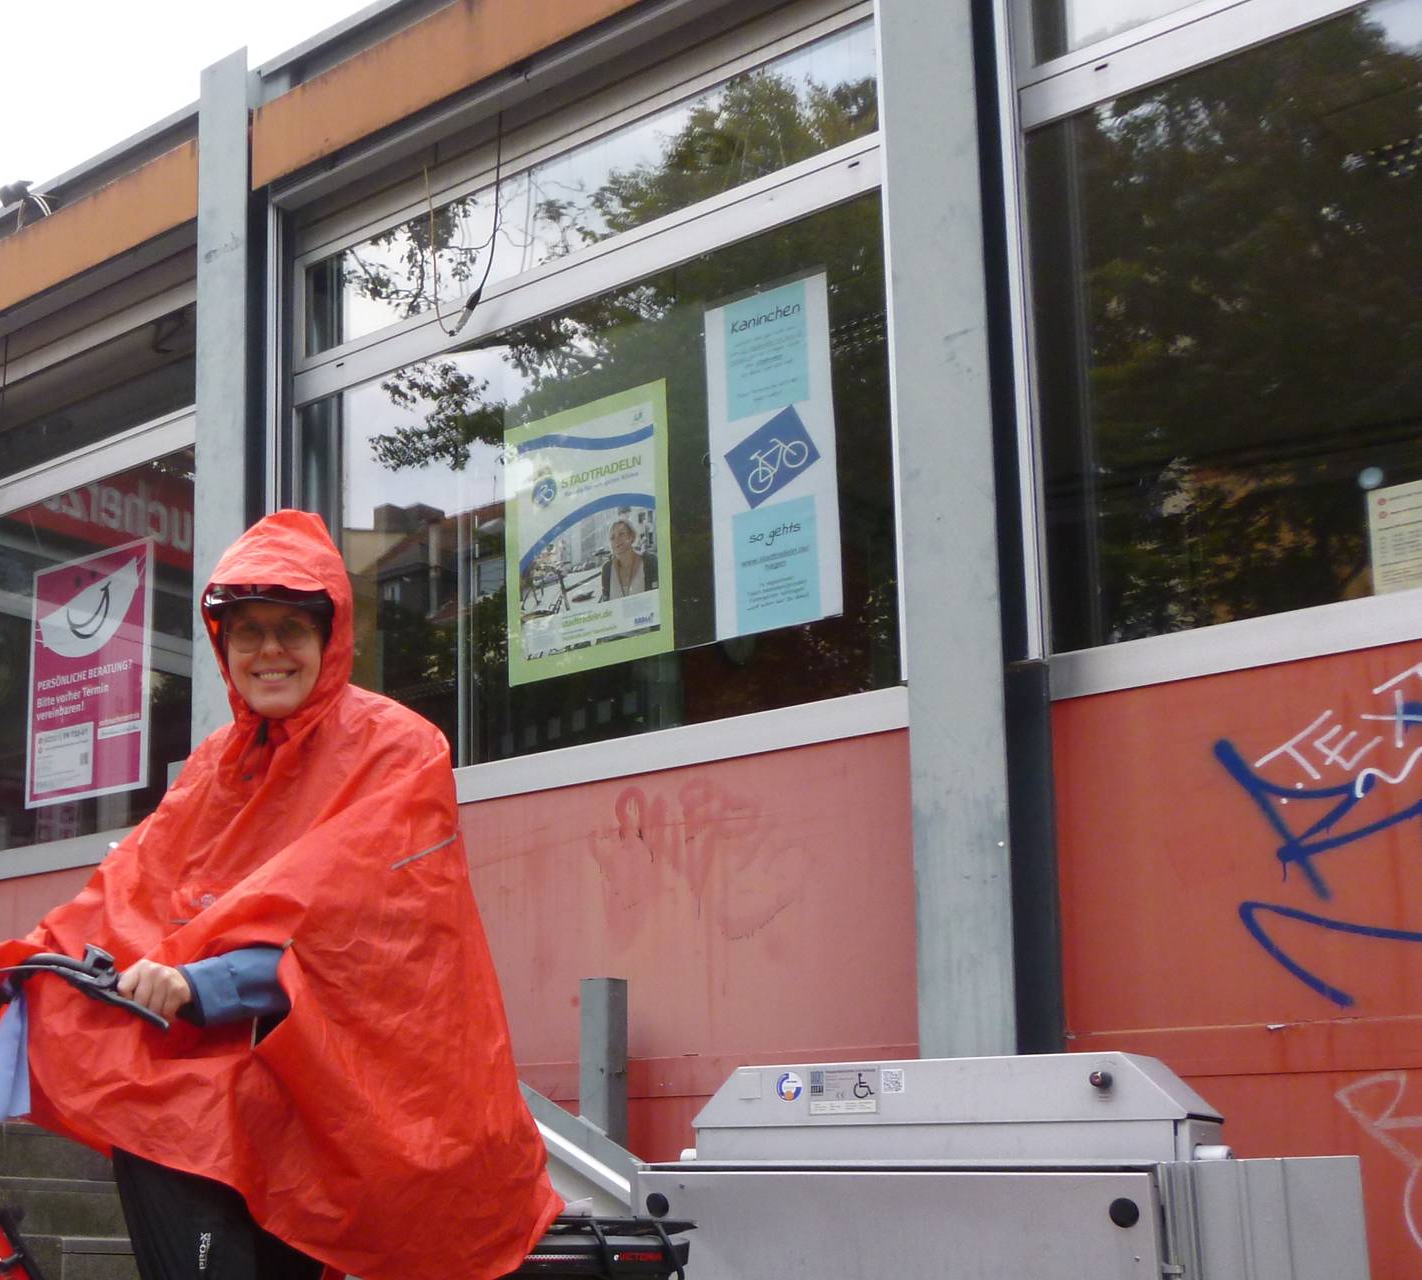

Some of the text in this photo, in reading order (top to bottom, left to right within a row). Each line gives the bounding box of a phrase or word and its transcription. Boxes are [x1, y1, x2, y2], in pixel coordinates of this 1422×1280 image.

[731, 304, 801, 334] Kaninchen
[561, 455, 642, 488] STADTRADELN
[748, 522, 802, 546] so gehts
[37, 659, 132, 691] PERSÖNLICHE BERATUNG?
[37, 683, 110, 708] Bitte vorher Termin
[36, 701, 84, 720] vereinbaren!
